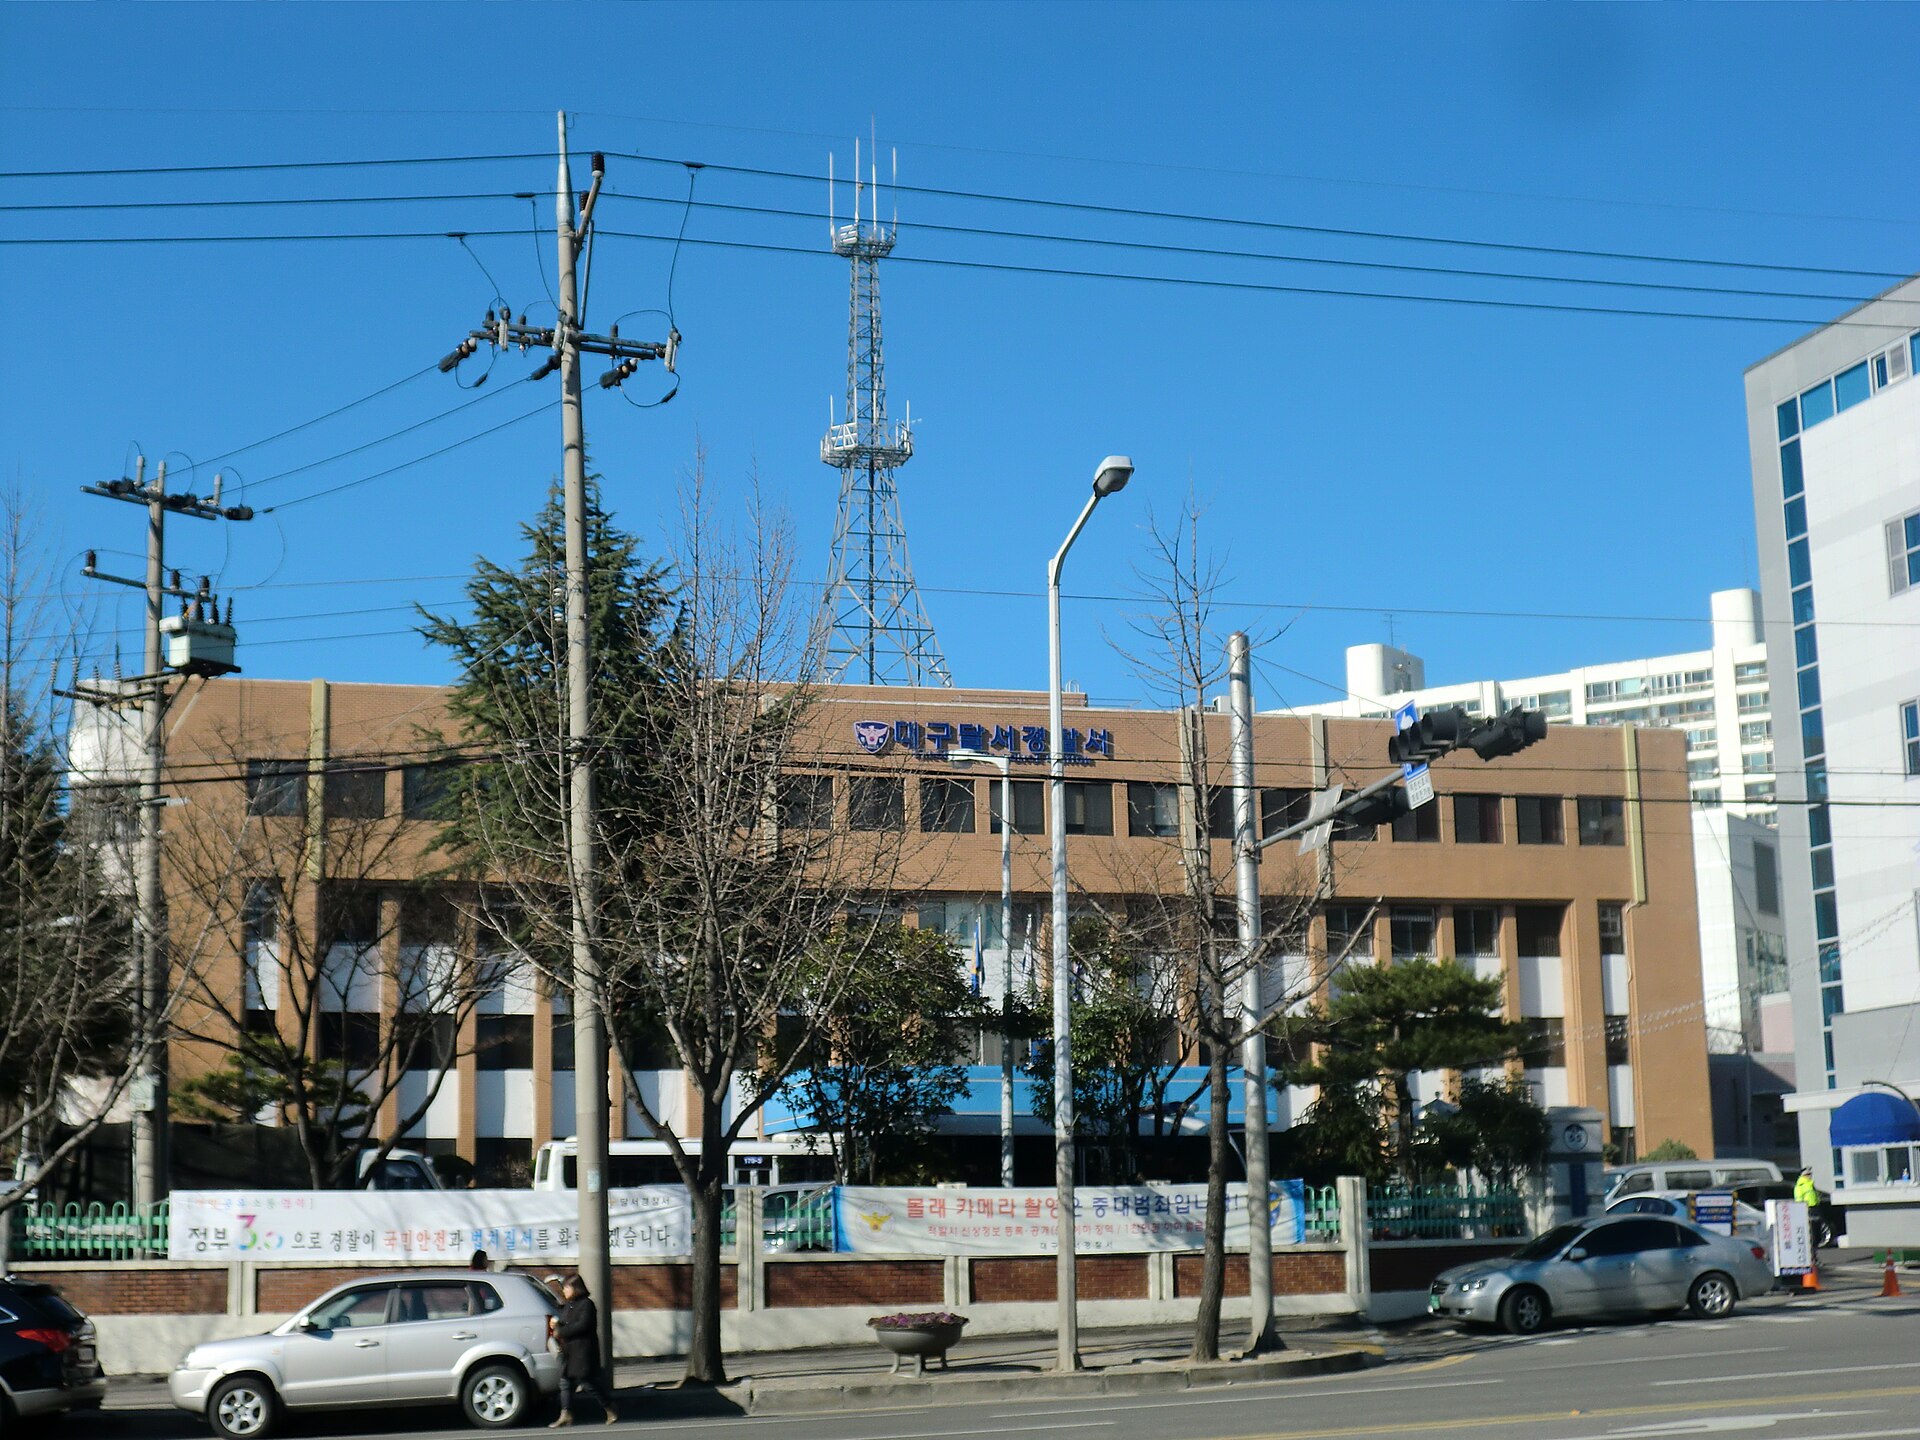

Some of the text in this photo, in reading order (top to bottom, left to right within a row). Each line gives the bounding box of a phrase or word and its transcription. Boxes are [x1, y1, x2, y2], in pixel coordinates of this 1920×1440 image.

[906, 1197, 947, 1219] 몰래
[956, 1197, 1016, 1219] 카메라
[330, 1229, 375, 1252] 경찰이
[383, 1229, 464, 1252] 국민안전과
[557, 1226, 677, 1250] 확겠습니다.
[961, 1224, 1001, 1238] 신상정보
